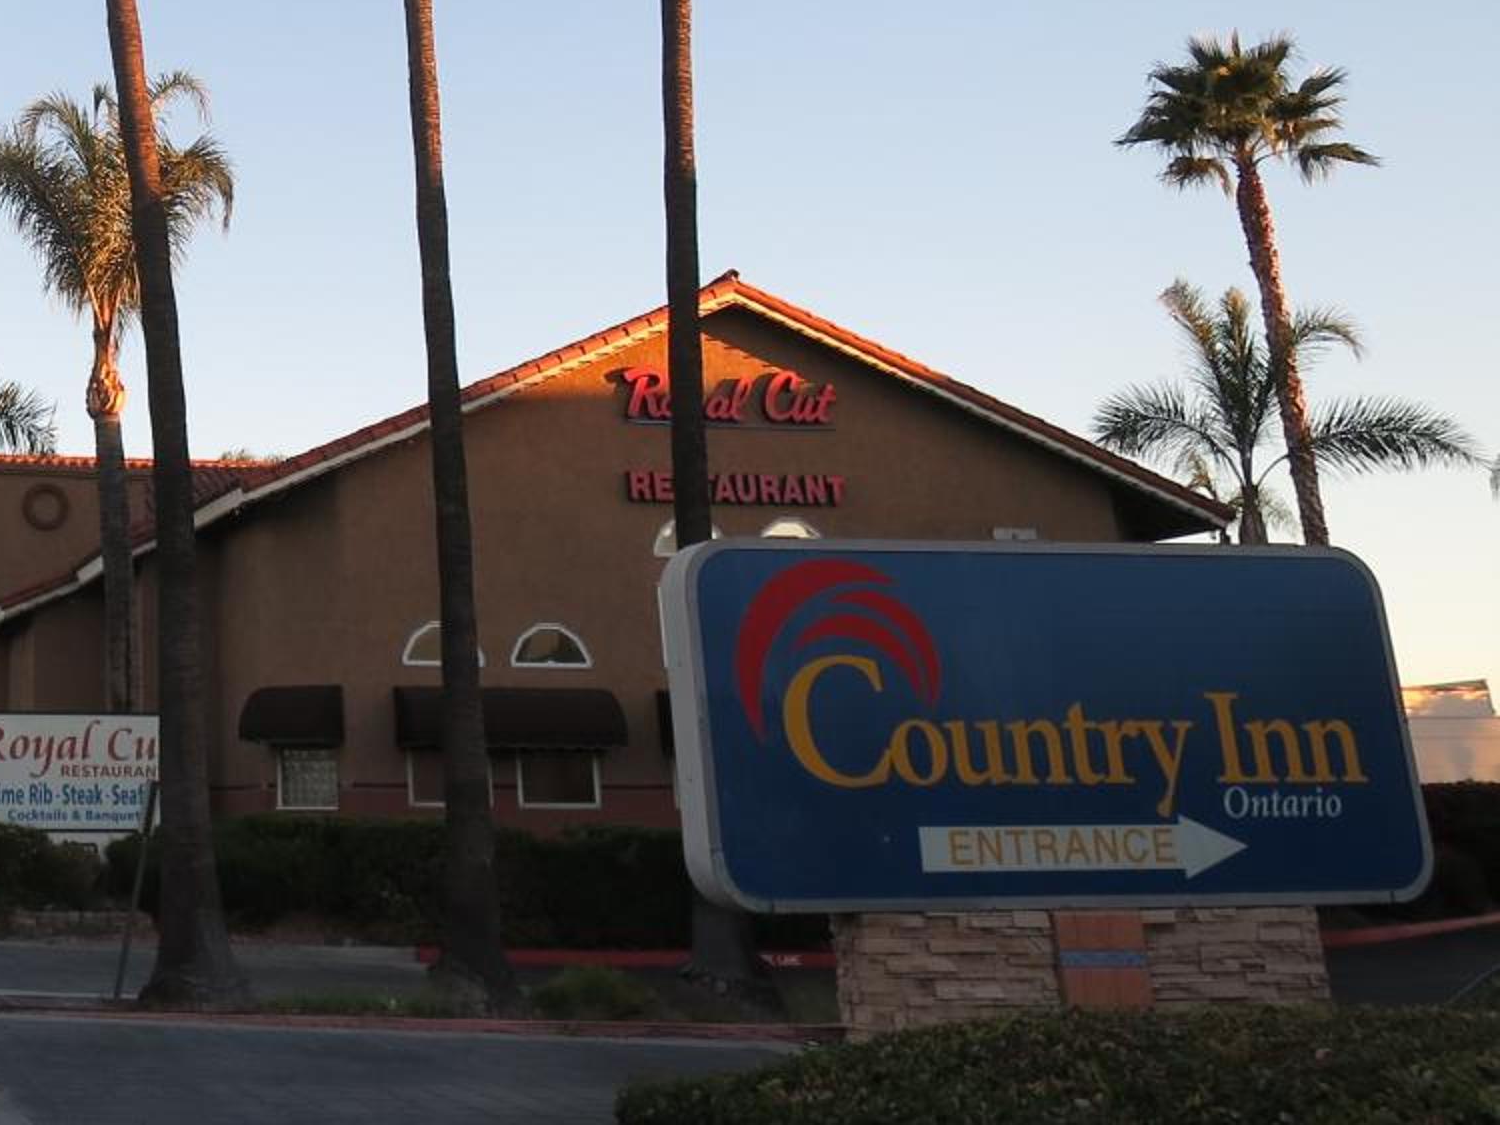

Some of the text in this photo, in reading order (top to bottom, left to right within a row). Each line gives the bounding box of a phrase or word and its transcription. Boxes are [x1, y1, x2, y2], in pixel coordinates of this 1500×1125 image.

[624, 368, 837, 423] Ral Cut
[629, 472, 846, 506] REAURANT
[107, 727, 157, 762] Cu
[782, 654, 1369, 818] Country Inn
[60, 765, 158, 778] RESTAURAN
[29, 782, 53, 805] Rib
[62, 783, 103, 806] Steak
[111, 783, 145, 806] Seaf
[1223, 787, 1343, 819] Ontario
[85, 809, 141, 824] Banquet
[948, 828, 1178, 867] ENTRANCE
